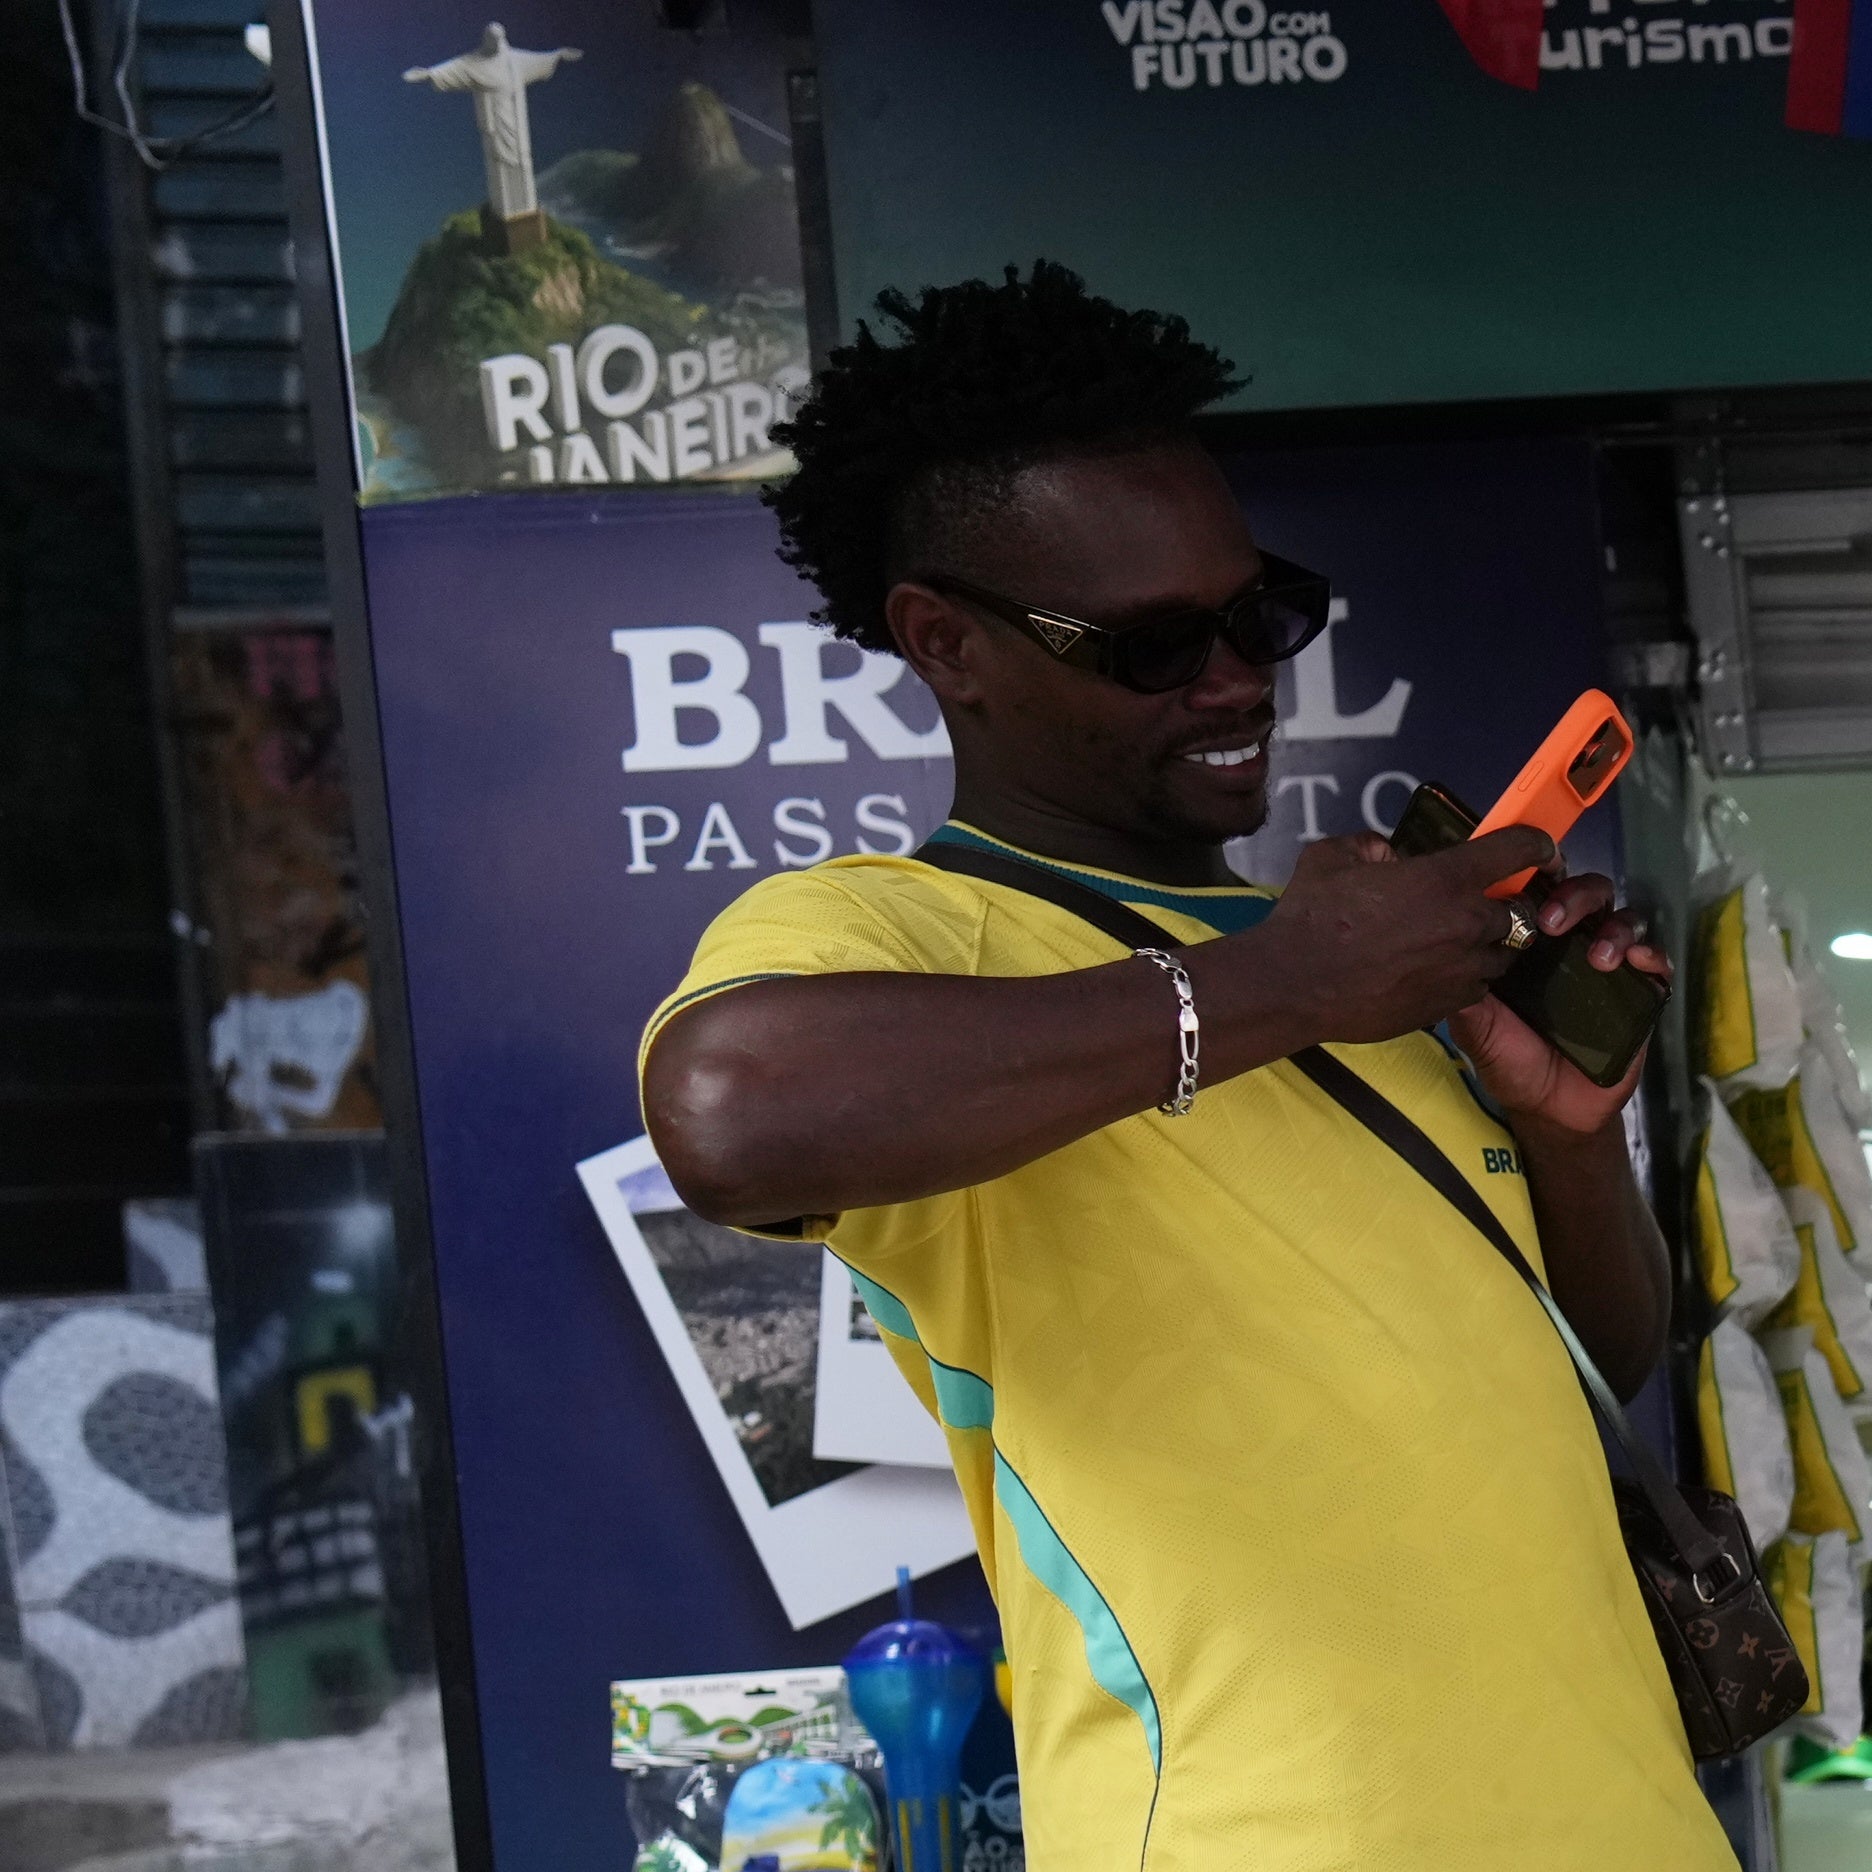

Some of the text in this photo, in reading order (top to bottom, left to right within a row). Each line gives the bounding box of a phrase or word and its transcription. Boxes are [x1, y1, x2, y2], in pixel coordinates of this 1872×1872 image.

[1132, 34, 1348, 91] FUTURO
[479, 323, 739, 452] RIO DE
